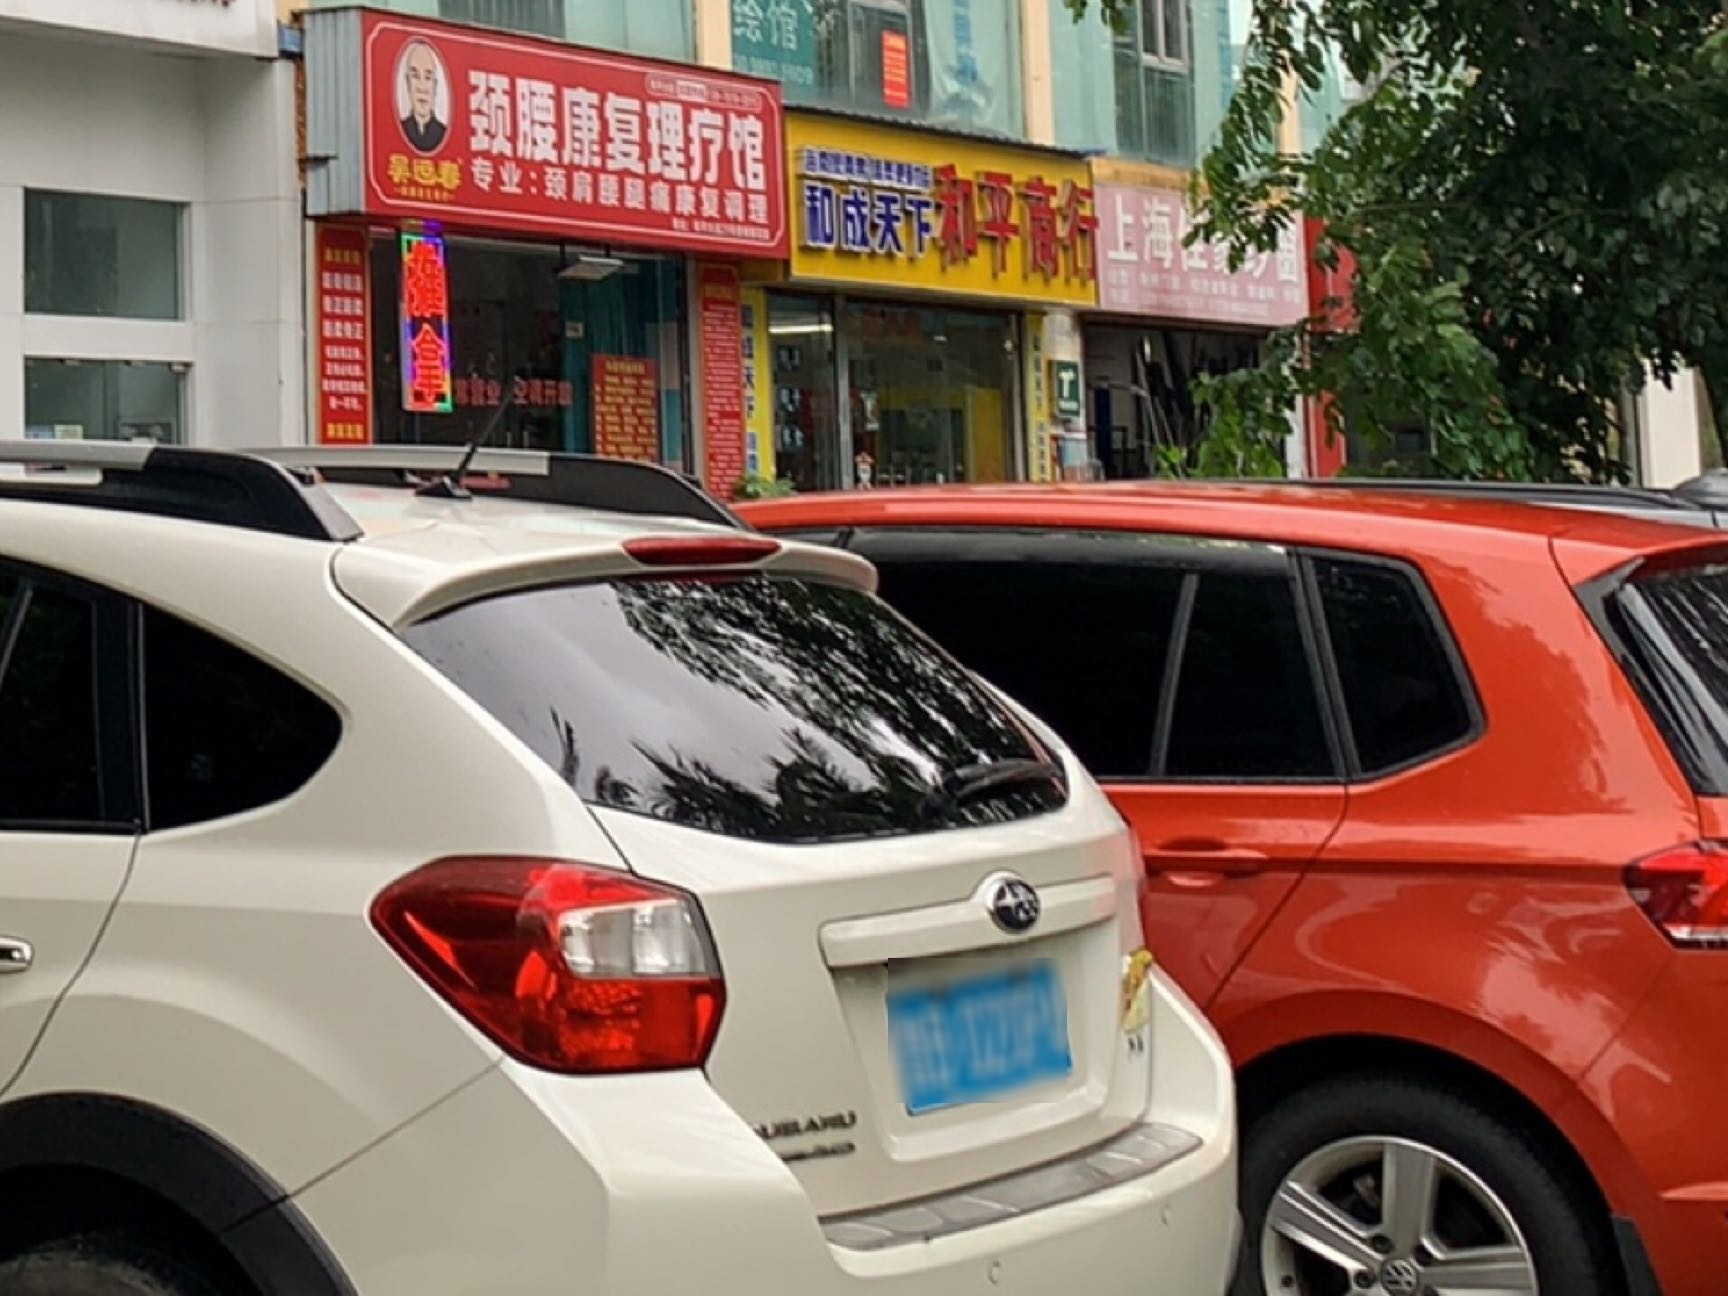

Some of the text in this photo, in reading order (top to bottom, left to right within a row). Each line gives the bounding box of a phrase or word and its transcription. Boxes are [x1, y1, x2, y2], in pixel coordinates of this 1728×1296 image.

[468, 69, 766, 190] 颈腰康复理疗馆
[805, 180, 936, 256] 和成天下
[933, 164, 1100, 284] 和平商行
[755, 1111, 857, 1140] UBARU
